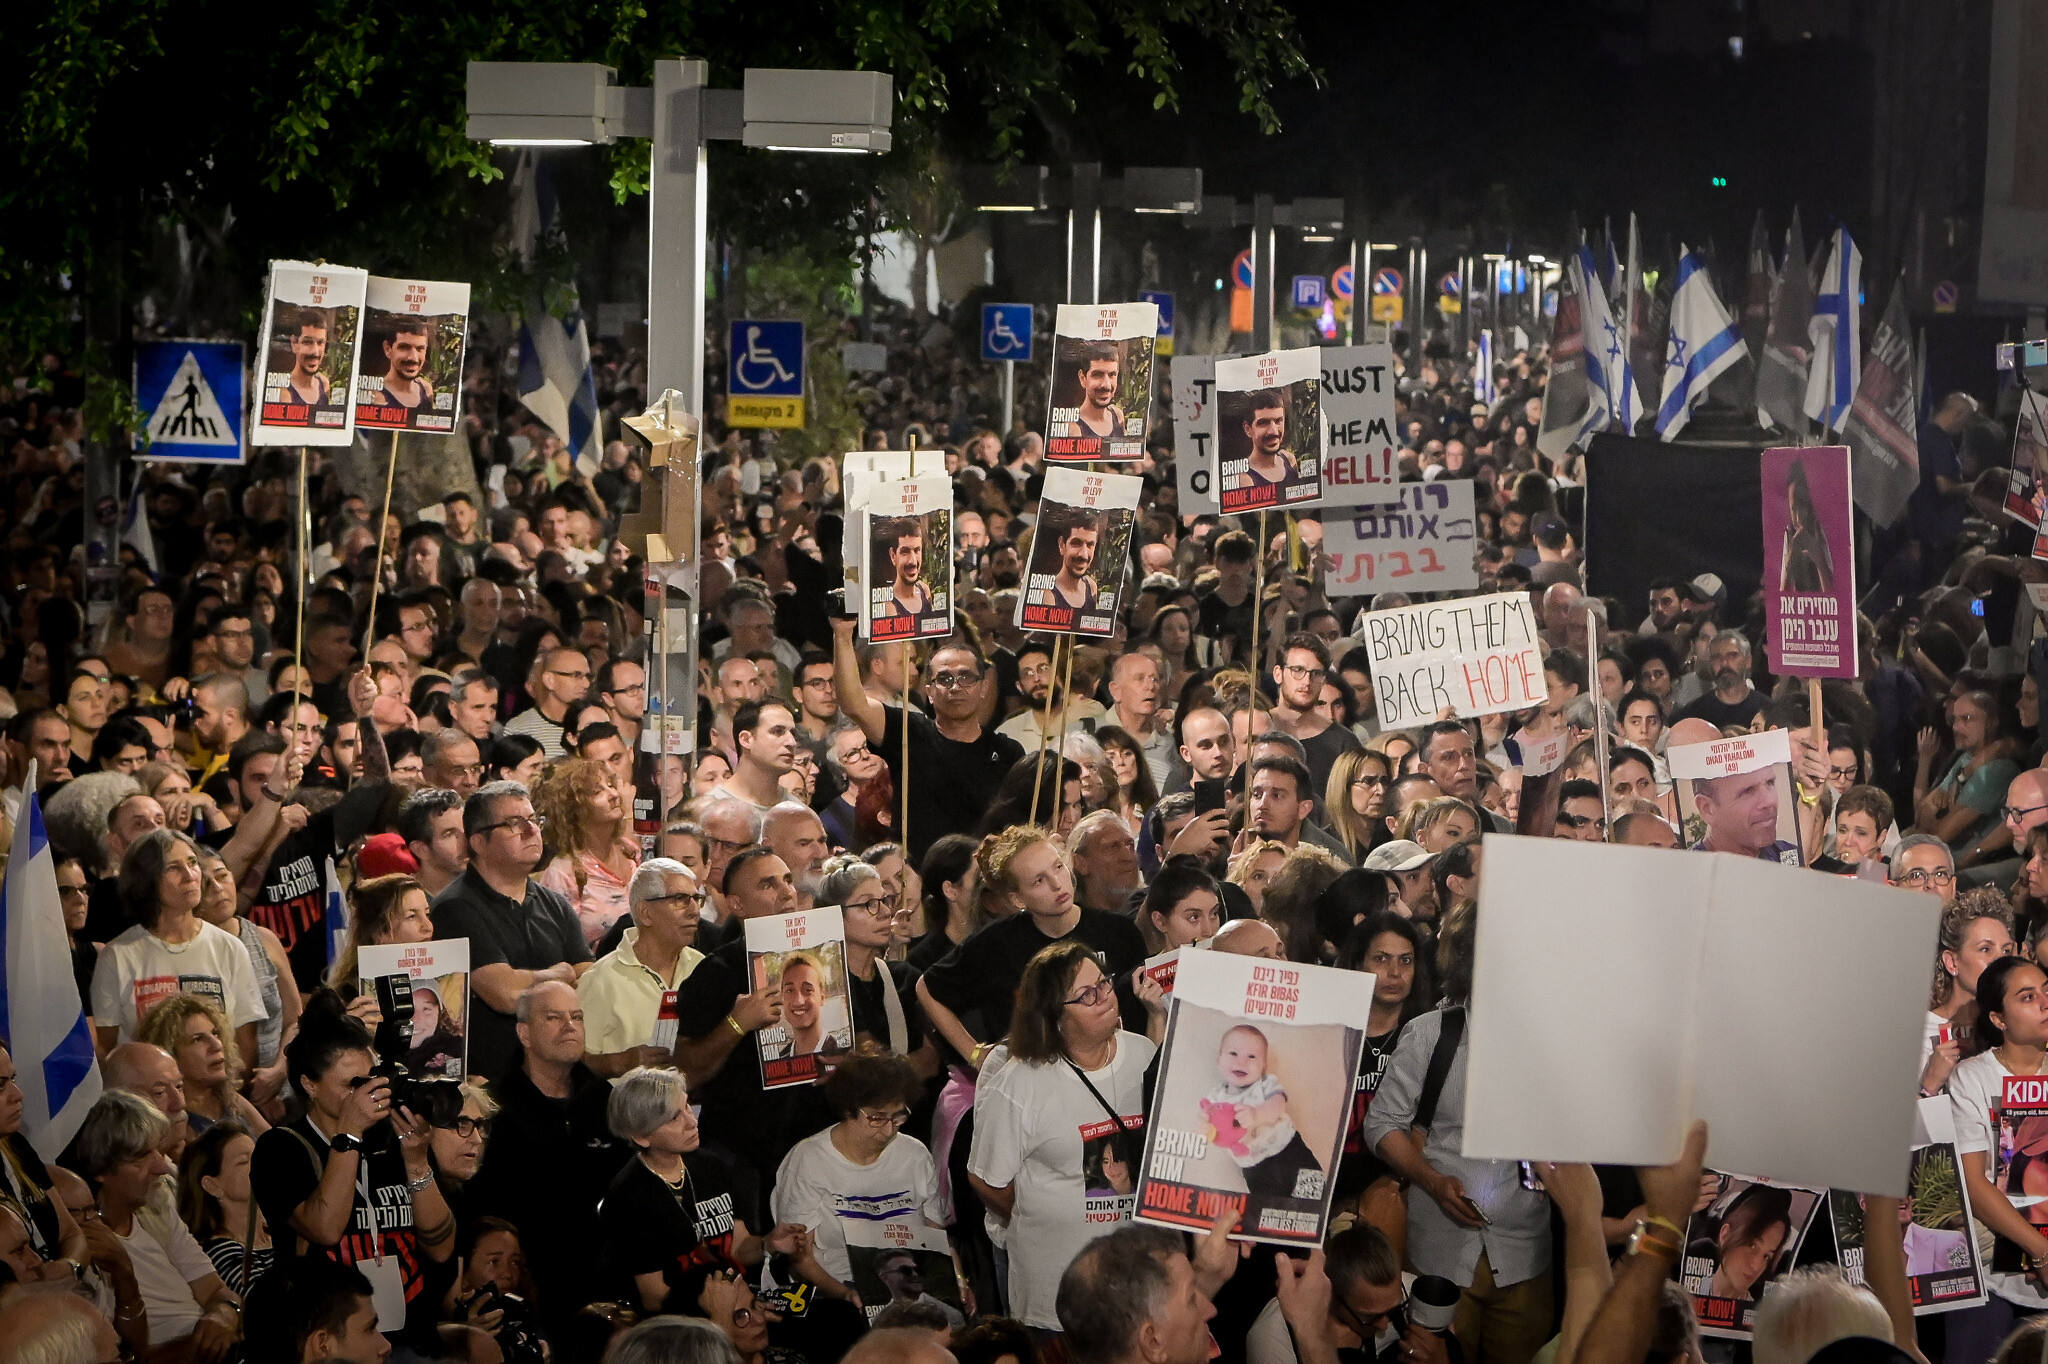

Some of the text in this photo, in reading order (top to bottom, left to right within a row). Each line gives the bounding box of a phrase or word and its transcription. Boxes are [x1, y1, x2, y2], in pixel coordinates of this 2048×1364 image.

[267, 372, 290, 388] BRING
[1265, 367, 1278, 377] LEVY
[357, 375, 384, 390] BRING
[265, 388, 280, 403] HIM
[263, 404, 285, 419] HOME
[286, 404, 309, 420] NOW!
[380, 407, 408, 422] NOW!
[786, 404, 795, 418] 2
[1052, 407, 1080, 422] BRING
[1050, 423, 1069, 437] HIM
[1328, 417, 1393, 447] HEM
[1049, 438, 1075, 453] HOME
[1076, 437, 1102, 453] NOW!
[1222, 457, 1250, 476] BRING
[1222, 475, 1240, 491] HIM
[1223, 488, 1248, 506] HOME
[1250, 482, 1277, 501] NOW!
[1354, 513, 1439, 540] אותם
[1030, 573, 1056, 590] BRING
[872, 586, 894, 602] BRING
[1027, 589, 1044, 605] HIM
[872, 602, 886, 619] HIM
[1780, 596, 1838, 615] מחזירים את
[1025, 606, 1048, 622] HOME
[1049, 608, 1073, 624] NOW!
[872, 618, 893, 635] HOME
[894, 614, 915, 634] NOW!
[1369, 598, 1531, 662] BRING THEM
[1780, 617, 1839, 651] ענבר הימן
[1379, 649, 1543, 724] BACK HOME
[1705, 749, 1755, 766] OHAD YAHALOMI
[1725, 762, 1739, 773] (49)
[1154, 969, 1166, 979] WE
[1253, 966, 1299, 985] כפיר ביבס
[182, 981, 221, 993] MURDERED
[1246, 982, 1300, 1003] KFIR BIBAS
[759, 1026, 786, 1046] BRING
[762, 1043, 780, 1062] HIM
[765, 1057, 791, 1079] HOME
[791, 1053, 816, 1075] NOW!
[1155, 1126, 1208, 1160] BRING
[1149, 1156, 1185, 1184] HIM
[1086, 1200, 1114, 1211] אותם
[1145, 1181, 1192, 1215] HOME
[1196, 1189, 1247, 1223] NOW!
[715, 1211, 735, 1234] ותם
[1085, 1211, 1121, 1224] עכשיו!
[1843, 1246, 1864, 1267] BRI
[1685, 1255, 1715, 1277] BRING
[1684, 1274, 1701, 1295] HER
[1932, 1284, 1956, 1297] FAMILIES
[1707, 1298, 1736, 1319] NOW!
